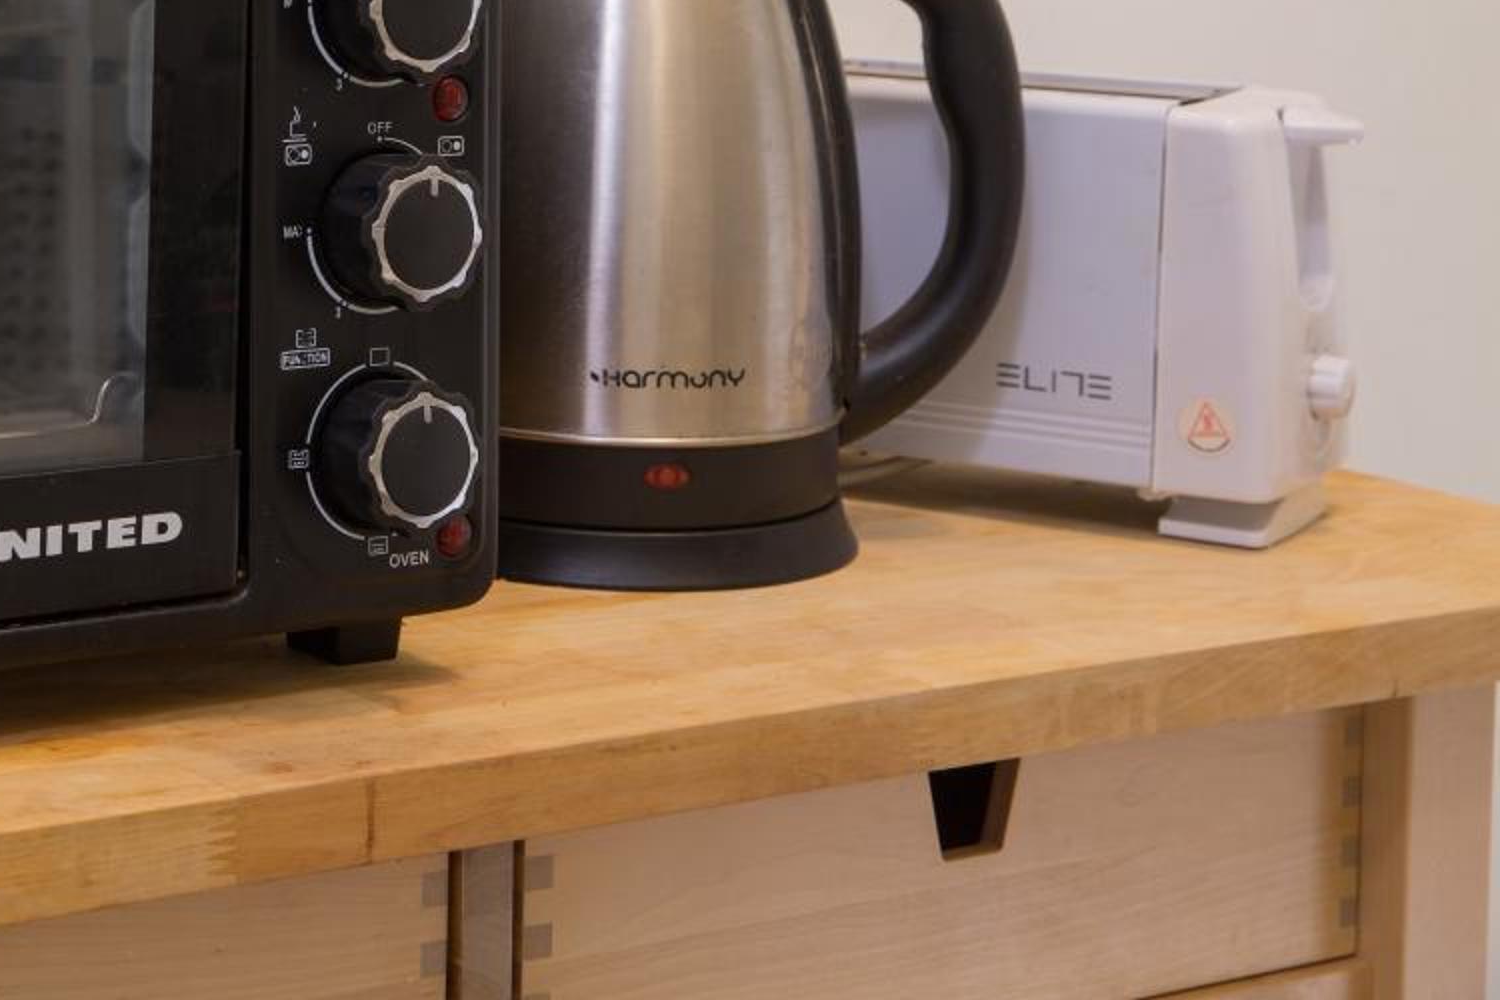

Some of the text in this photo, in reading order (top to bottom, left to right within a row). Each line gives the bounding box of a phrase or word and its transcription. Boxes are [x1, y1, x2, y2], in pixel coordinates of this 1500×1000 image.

[367, 122, 393, 135] OFF
[996, 362, 1112, 401] ELITE
[389, 550, 429, 568] OVEN
